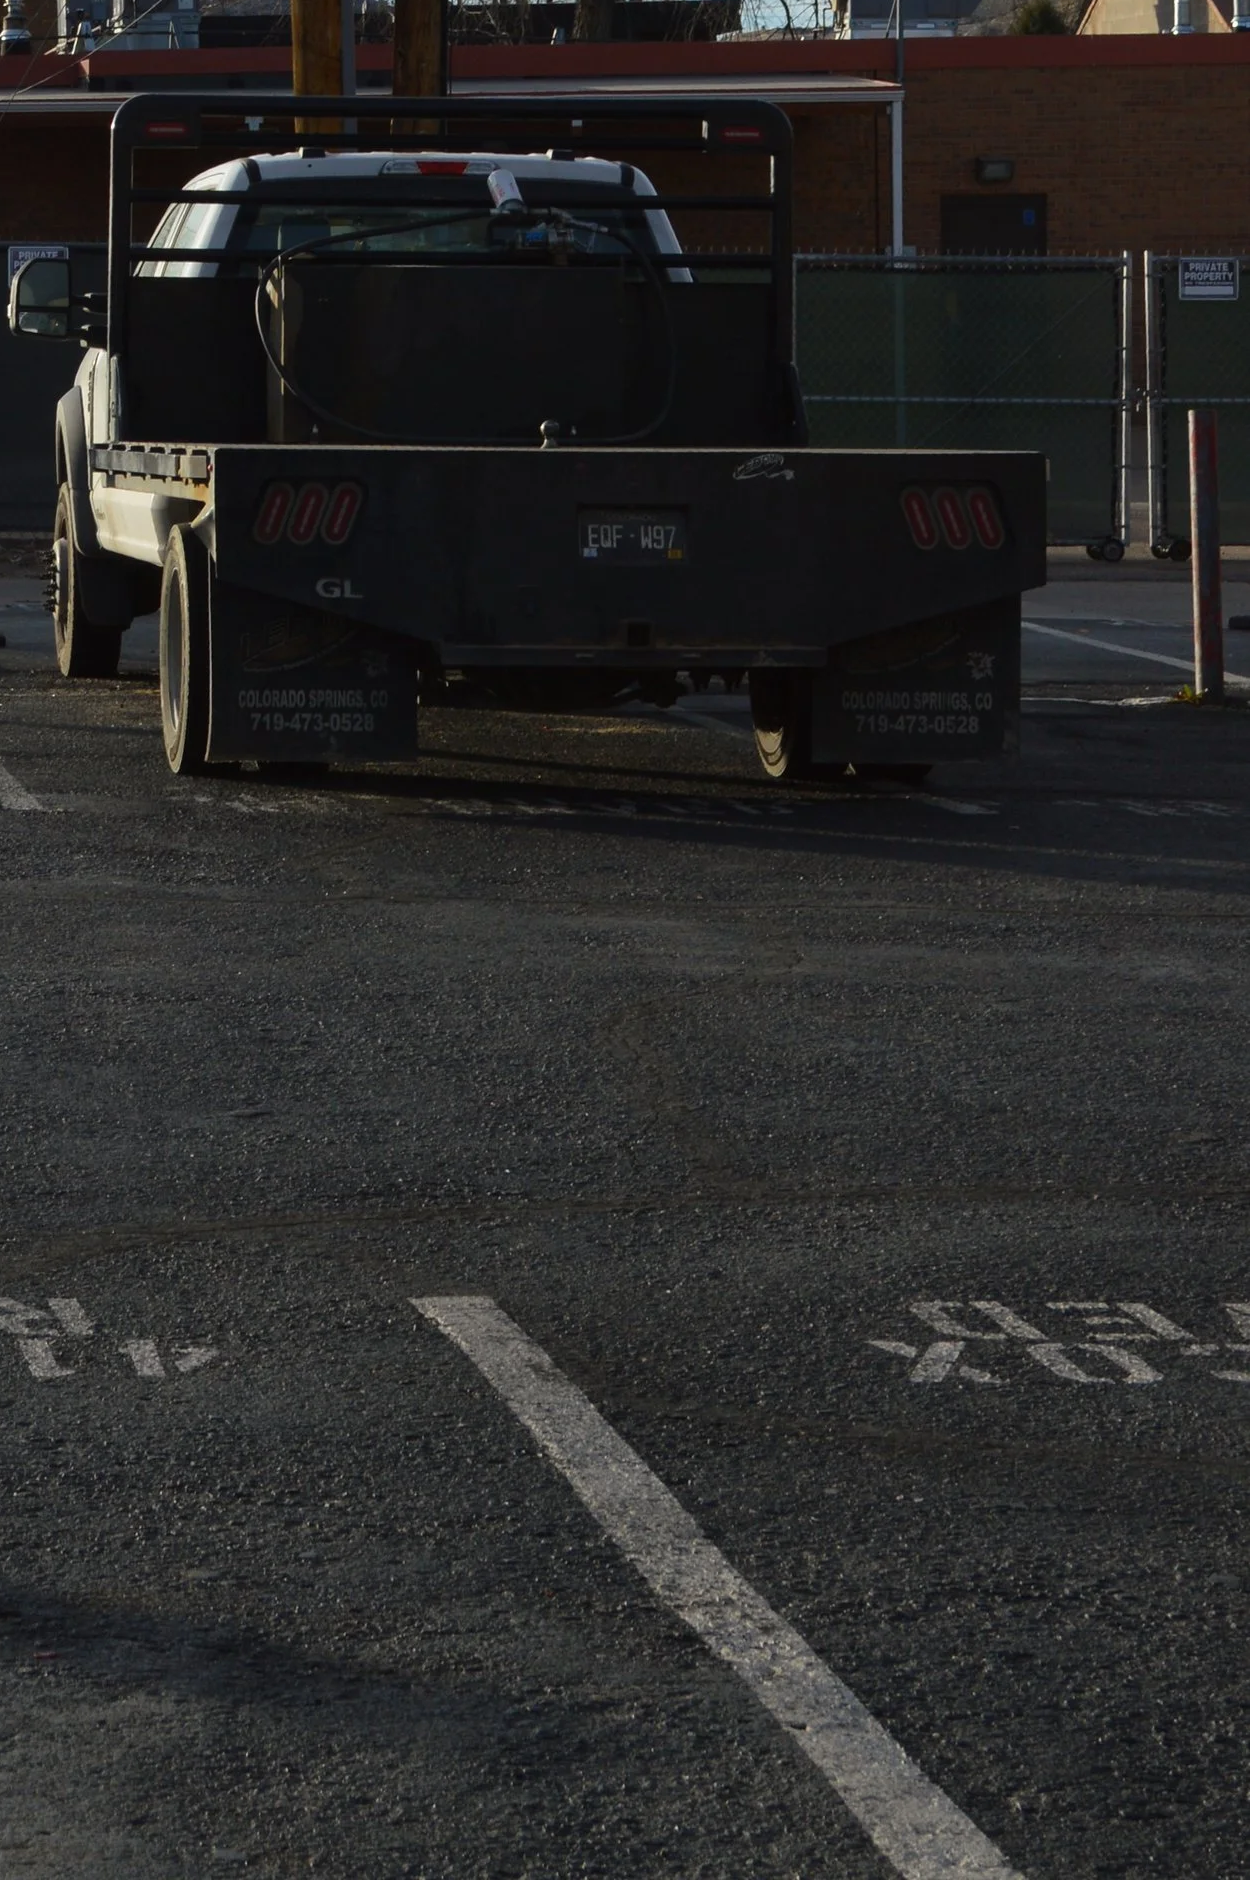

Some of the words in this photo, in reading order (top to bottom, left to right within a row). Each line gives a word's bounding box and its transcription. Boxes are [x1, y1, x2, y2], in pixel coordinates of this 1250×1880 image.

[1184, 271, 1233, 281] PROPERTY
[1190, 262, 1229, 271] PRIVATE
[315, 576, 366, 599] GL
[238, 688, 306, 708] COLORADO
[308, 689, 367, 710] SPRINGS,
[370, 689, 389, 708] CO
[841, 690, 910, 710] COLORADO
[913, 691, 972, 712] SPRINGS,
[975, 692, 993, 710] CO
[250, 712, 375, 732] 719-473-0528
[855, 714, 980, 734] 719-473-0528
